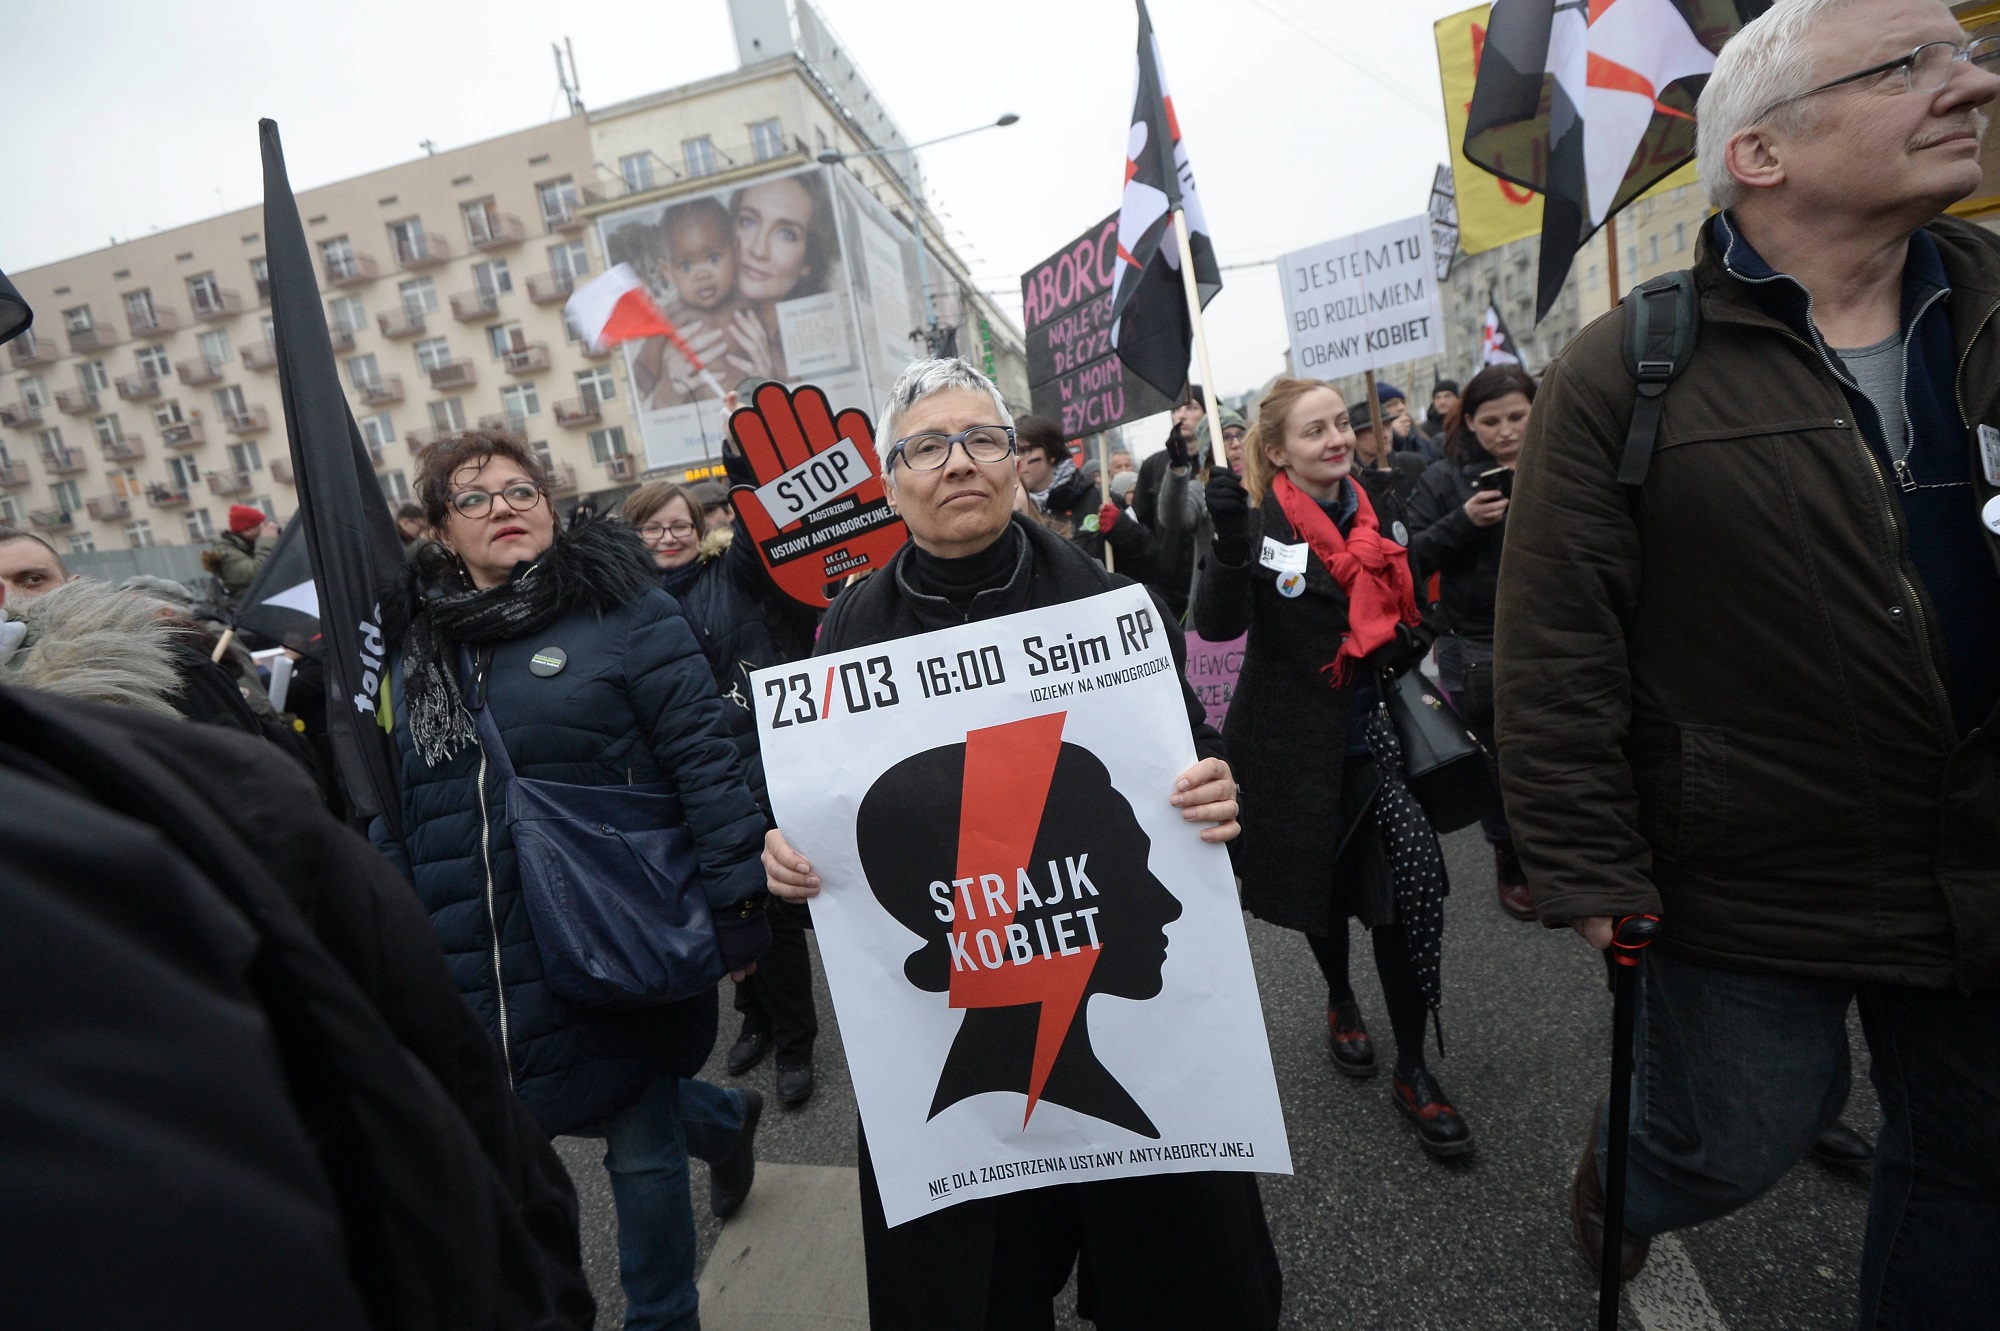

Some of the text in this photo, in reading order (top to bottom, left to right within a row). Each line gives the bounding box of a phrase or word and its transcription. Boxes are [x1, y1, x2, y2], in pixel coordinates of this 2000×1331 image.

[1024, 218, 1119, 328] ABORC
[1296, 244, 1391, 292] JESTEM
[1394, 235, 1420, 264] TU
[1295, 278, 1424, 332] BO ROZUMIEM
[1302, 316, 1430, 368] OBAWY KOBIET
[1059, 356, 1123, 401] W MOIM
[684, 467, 710, 482] BAR
[776, 450, 850, 513] STOP
[770, 505, 895, 560] USTAWY ANTYABORCYJNEJ
[808, 499, 855, 524] ZAOSTRZENIU
[764, 608, 1154, 729] 23/03 16:00 Sejm RP
[1030, 655, 1171, 703] IDZIEMY NA NOWOGRODZKĄ
[929, 853, 1100, 923] STRAJK
[945, 906, 1100, 972] KOBIET
[928, 1142, 1255, 1198] NIE DLA ZAOSTRZENIA USTAWY ANTYABORCYJNEJ
